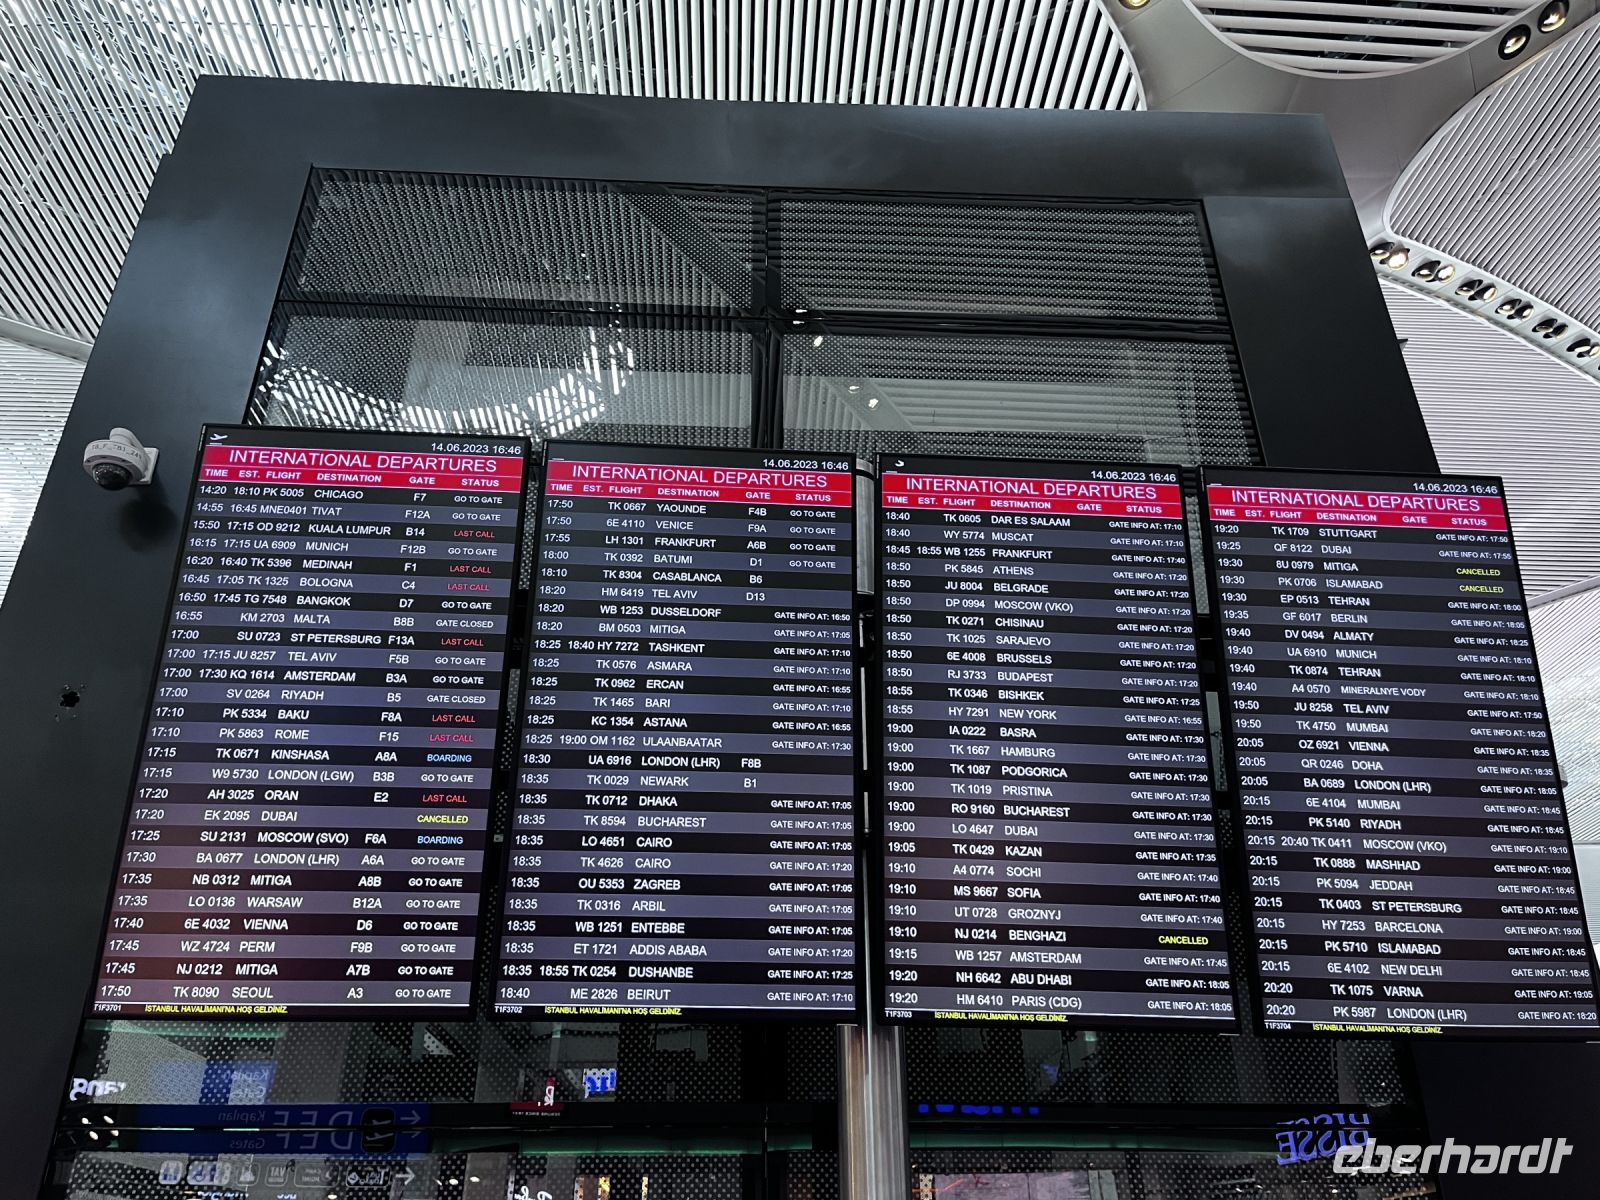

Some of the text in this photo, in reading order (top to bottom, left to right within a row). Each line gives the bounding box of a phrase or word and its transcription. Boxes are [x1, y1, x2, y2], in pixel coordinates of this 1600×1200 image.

[431, 441, 522, 455] 14.06.2023 16:46
[228, 448, 497, 473] INTERNATIONAL DEPARTURES
[762, 458, 849, 471] 14.06.2023 16:46
[204, 467, 500, 488] TIME EST. FLIGHT DESTINATION GATE STATUS
[572, 464, 828, 488] INTERNATIONAL DEPARTURES
[1090, 469, 1177, 483] 14.06.2023 16:46
[200, 484, 503, 504] 14:20 18:10 PK 5005 CHICAGO F7 GO TO GATE
[550, 483, 832, 502] TIME EST. FLIGHT DESTINATION GATE STATUS
[906, 476, 1157, 500] INTERNATIONAL DEPARTURES
[1412, 481, 1498, 495] 14.06.2023 16:46
[886, 495, 1162, 514] TIME EST. FLIGHT DESTINATION GATE STATUS
[1231, 489, 1480, 512] INTERNATIONAL DEPARTURES
[1212, 507, 1487, 526] TIME EST. FLIGHT DESTINATION GATE STATUS
[885, 544, 1186, 564] 18:45 18:55 WB 1255 FRANKFURT GATE INFO AT: 17:40
[541, 567, 763, 584] 18:10 TK 8304 CASABLANCA B6
[1219, 574, 1504, 594] 19:30 PK 0706 ISLAMABAD CANCELLED
[171, 628, 484, 647] 17:00 SU 0723 ST PETERSBURG F13A LAST CALL
[1231, 681, 1539, 701] 19:40 A4 0570 MINERALNYE VODY GATE INFO AT: 18:10
[886, 722, 1204, 744] 19:00 IA 0222 BASRA GATE INFO AT: 17:30
[522, 752, 762, 770] 18:30 UA 6916 LONDON (LHR) F8B
[1247, 835, 1568, 855] 20:15 20:40 TK 0411 MOSCOW (VKO) GATE INFO AT: 19:10
[122, 872, 463, 888] 17:35 NB 0312 MITIGA A8B GO TO GATE
[888, 925, 1209, 946] 19:10 NJ 0214 BENGHAZI CANCELLED
[502, 963, 854, 980] 18:35 18:55 TK 0254 DUSHANBE GATE INFO AT: 17:25
[93, 1003, 122, 1012] T1F3701
[494, 1005, 523, 1014] T1F3702
[884, 1009, 913, 1019] T1F3703
[1264, 1021, 1292, 1030] T1F3704
